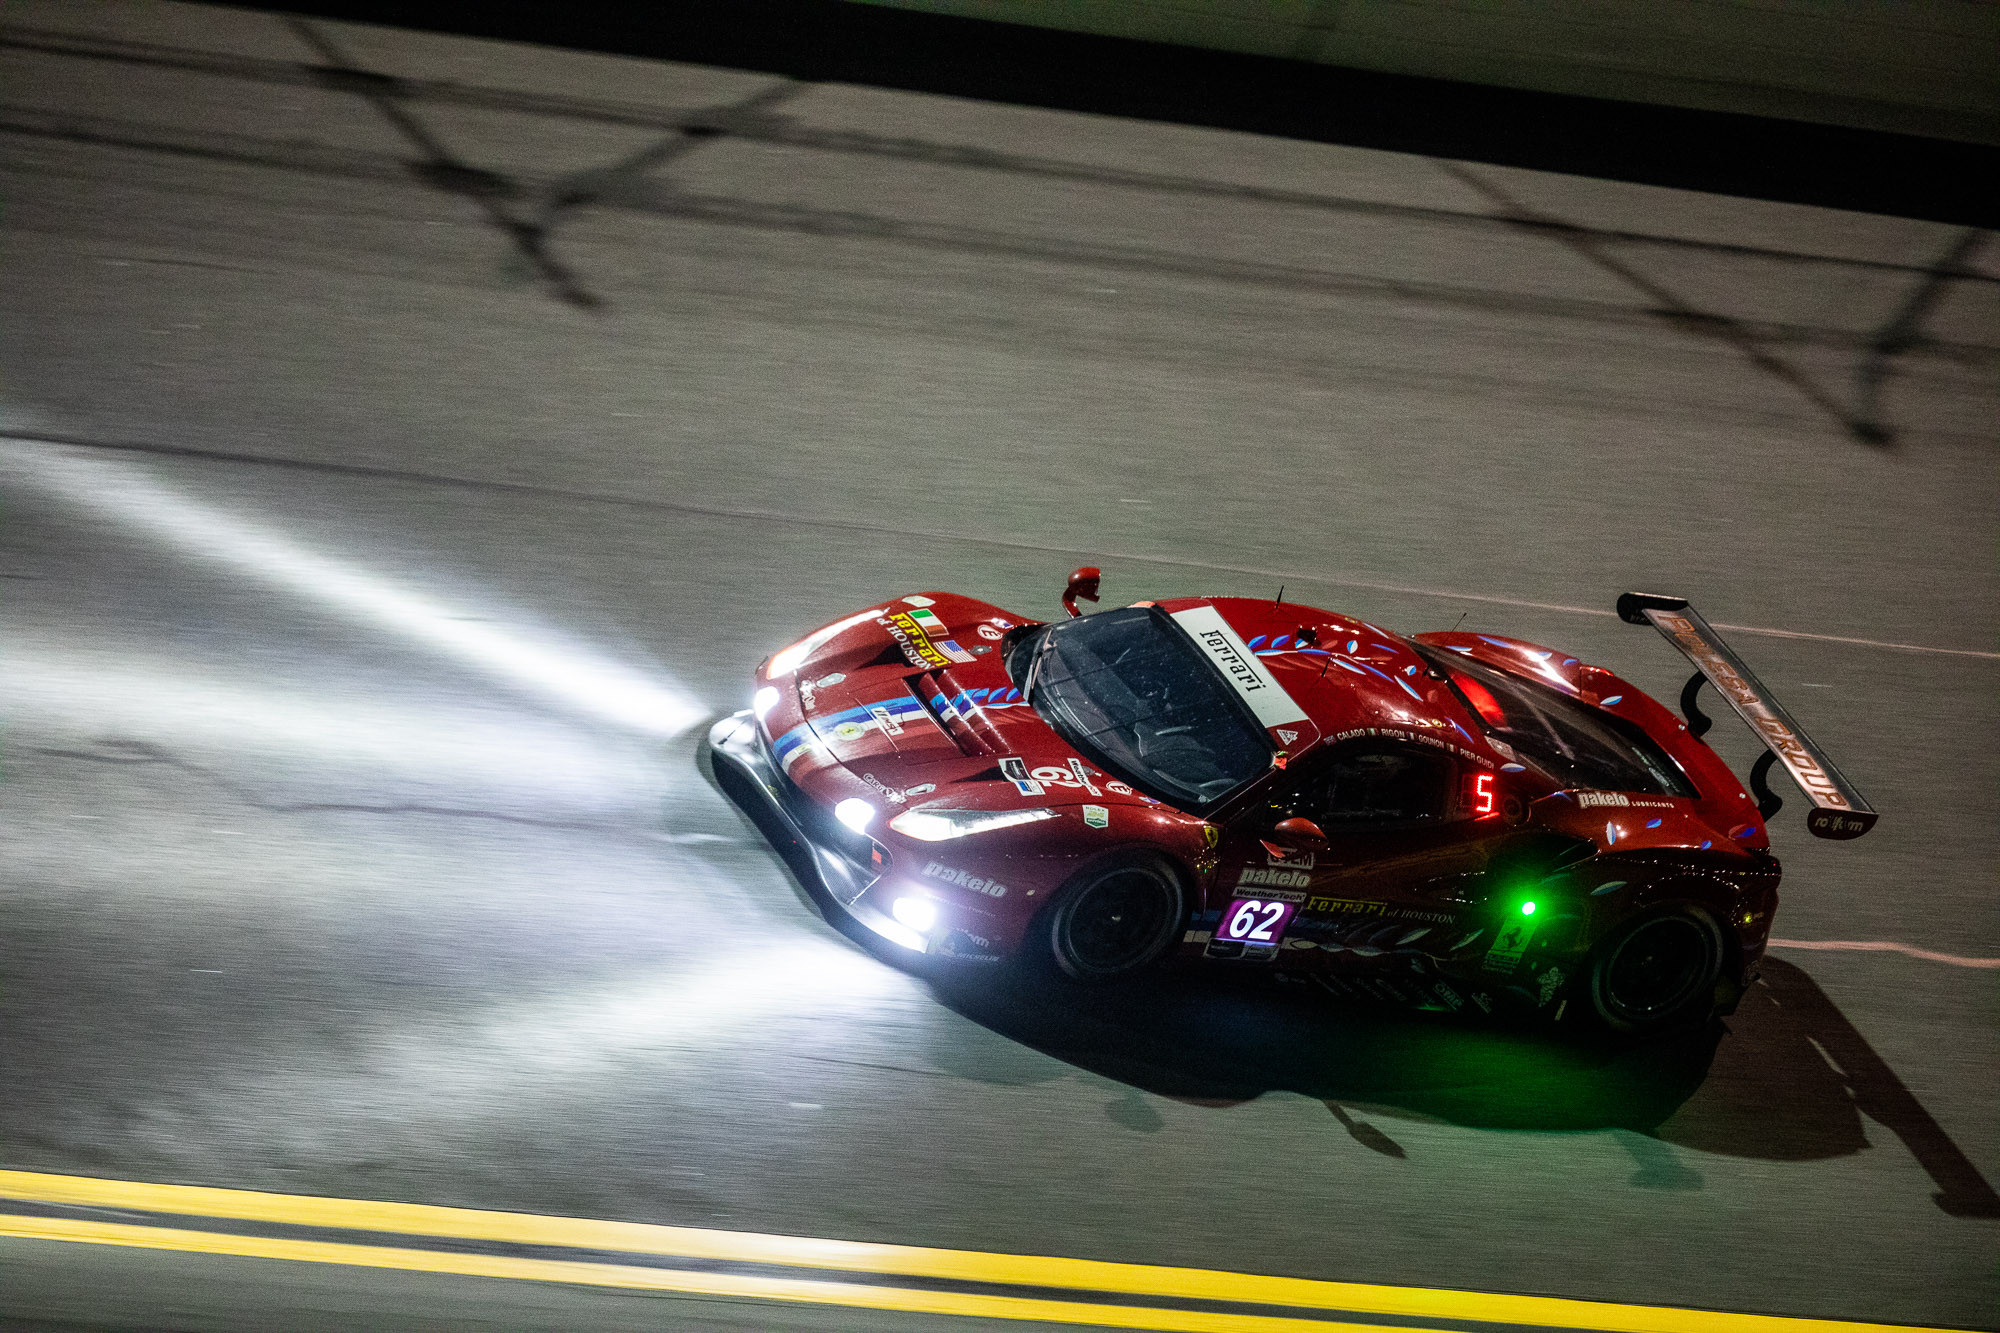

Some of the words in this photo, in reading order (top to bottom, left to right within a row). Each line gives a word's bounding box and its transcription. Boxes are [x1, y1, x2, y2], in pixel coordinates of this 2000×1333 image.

[877, 617, 894, 626] of
[886, 624, 936, 670] HOUSTON
[888, 612, 952, 667] Ferrari
[1199, 630, 1266, 692] Ferrari
[1337, 728, 1366, 740] CALADO
[1381, 728, 1405, 738] RIGON
[1418, 734, 1445, 749] GOUNON
[1460, 748, 1476, 761] PIER
[1476, 755, 1495, 770] GUIDI
[1755, 717, 1847, 807] GROUP
[1031, 766, 1083, 787] 62
[1476, 774, 1494, 812] 5
[1577, 791, 1630, 809] pakelo
[1631, 801, 1675, 809] LUBRICANTS
[921, 860, 1007, 898] pakelo
[1237, 867, 1312, 888] pakelo
[1236, 888, 1305, 901] WeatherTech
[1229, 900, 1285, 940] 62
[1305, 896, 1389, 917] Ferrari
[1387, 908, 1400, 918] of
[1400, 910, 1457, 924] HOUSTON
